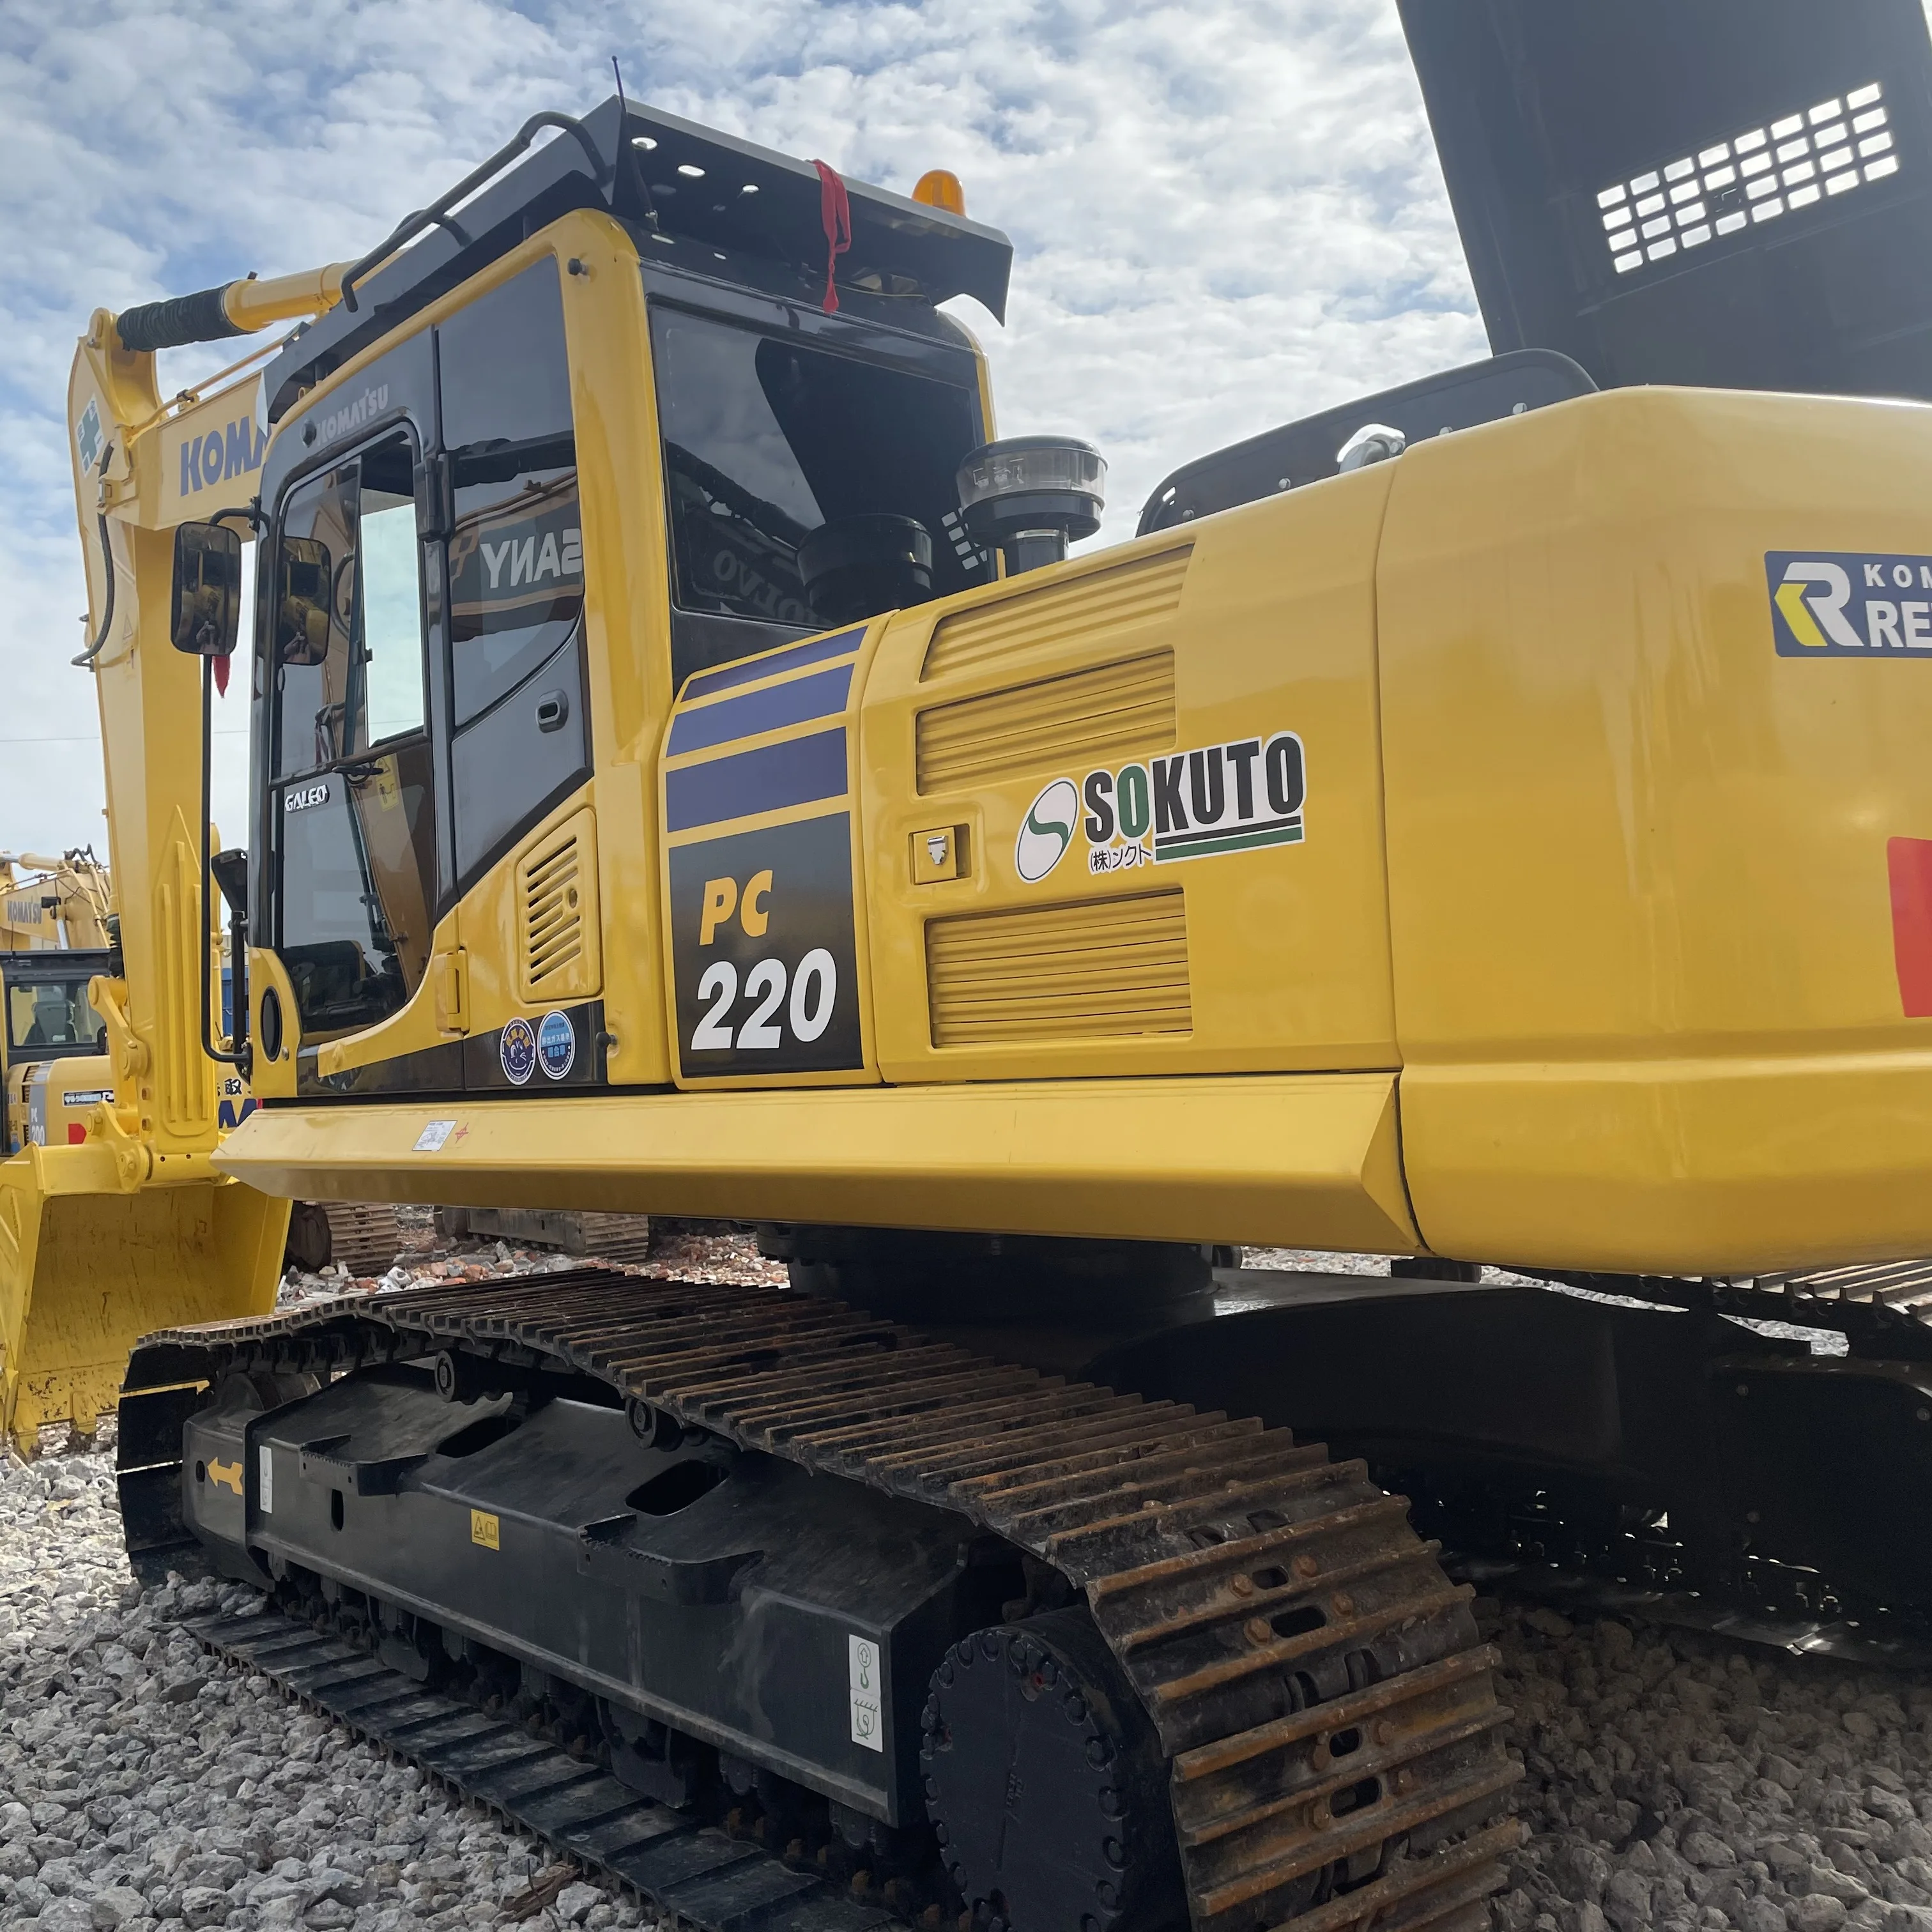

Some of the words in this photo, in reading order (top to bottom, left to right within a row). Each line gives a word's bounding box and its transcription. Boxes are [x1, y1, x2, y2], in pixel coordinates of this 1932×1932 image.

[317, 384, 388, 446] KOMATSU
[1865, 600, 1932, 648] RE
[285, 784, 328, 812] GALEO
[1085, 736, 1303, 843] SOKUTO
[699, 870, 773, 946] PC
[691, 947, 837, 1050] 220
